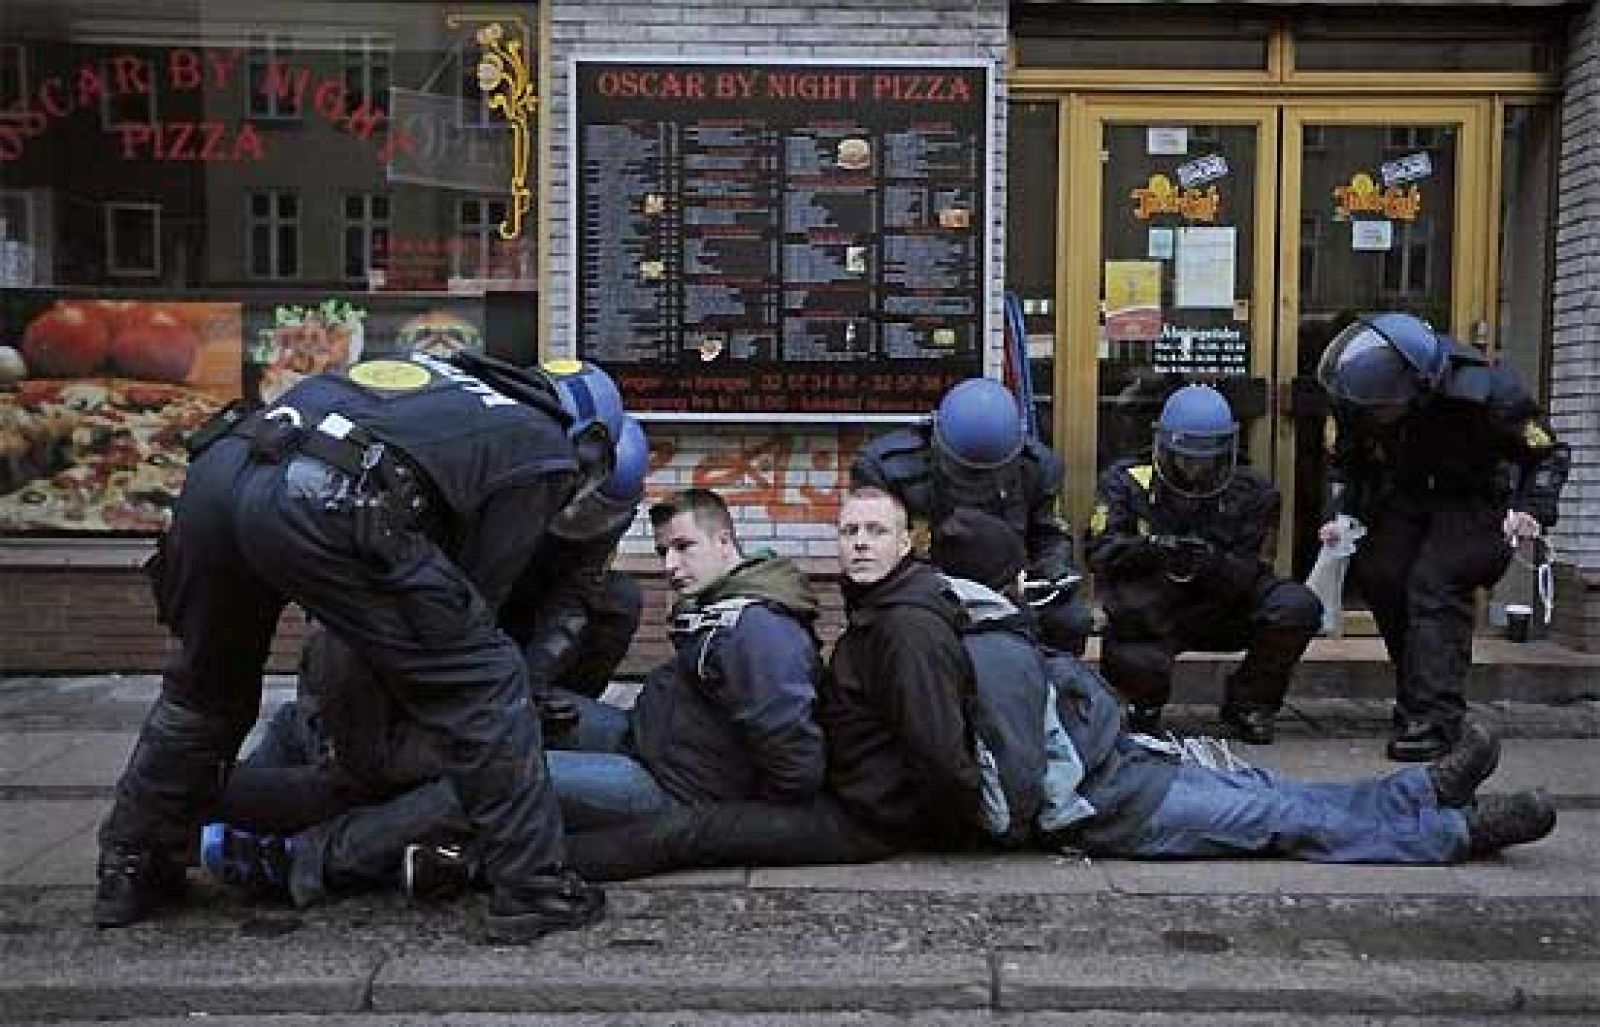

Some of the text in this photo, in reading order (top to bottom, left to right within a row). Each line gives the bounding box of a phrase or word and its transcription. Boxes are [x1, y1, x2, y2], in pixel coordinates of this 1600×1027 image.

[0, 54, 151, 161] OSCAR
[168, 48, 241, 90] BY
[600, 71, 971, 101] OSCAR BY NIGHT PIZZA
[118, 120, 265, 161] PIZZA
